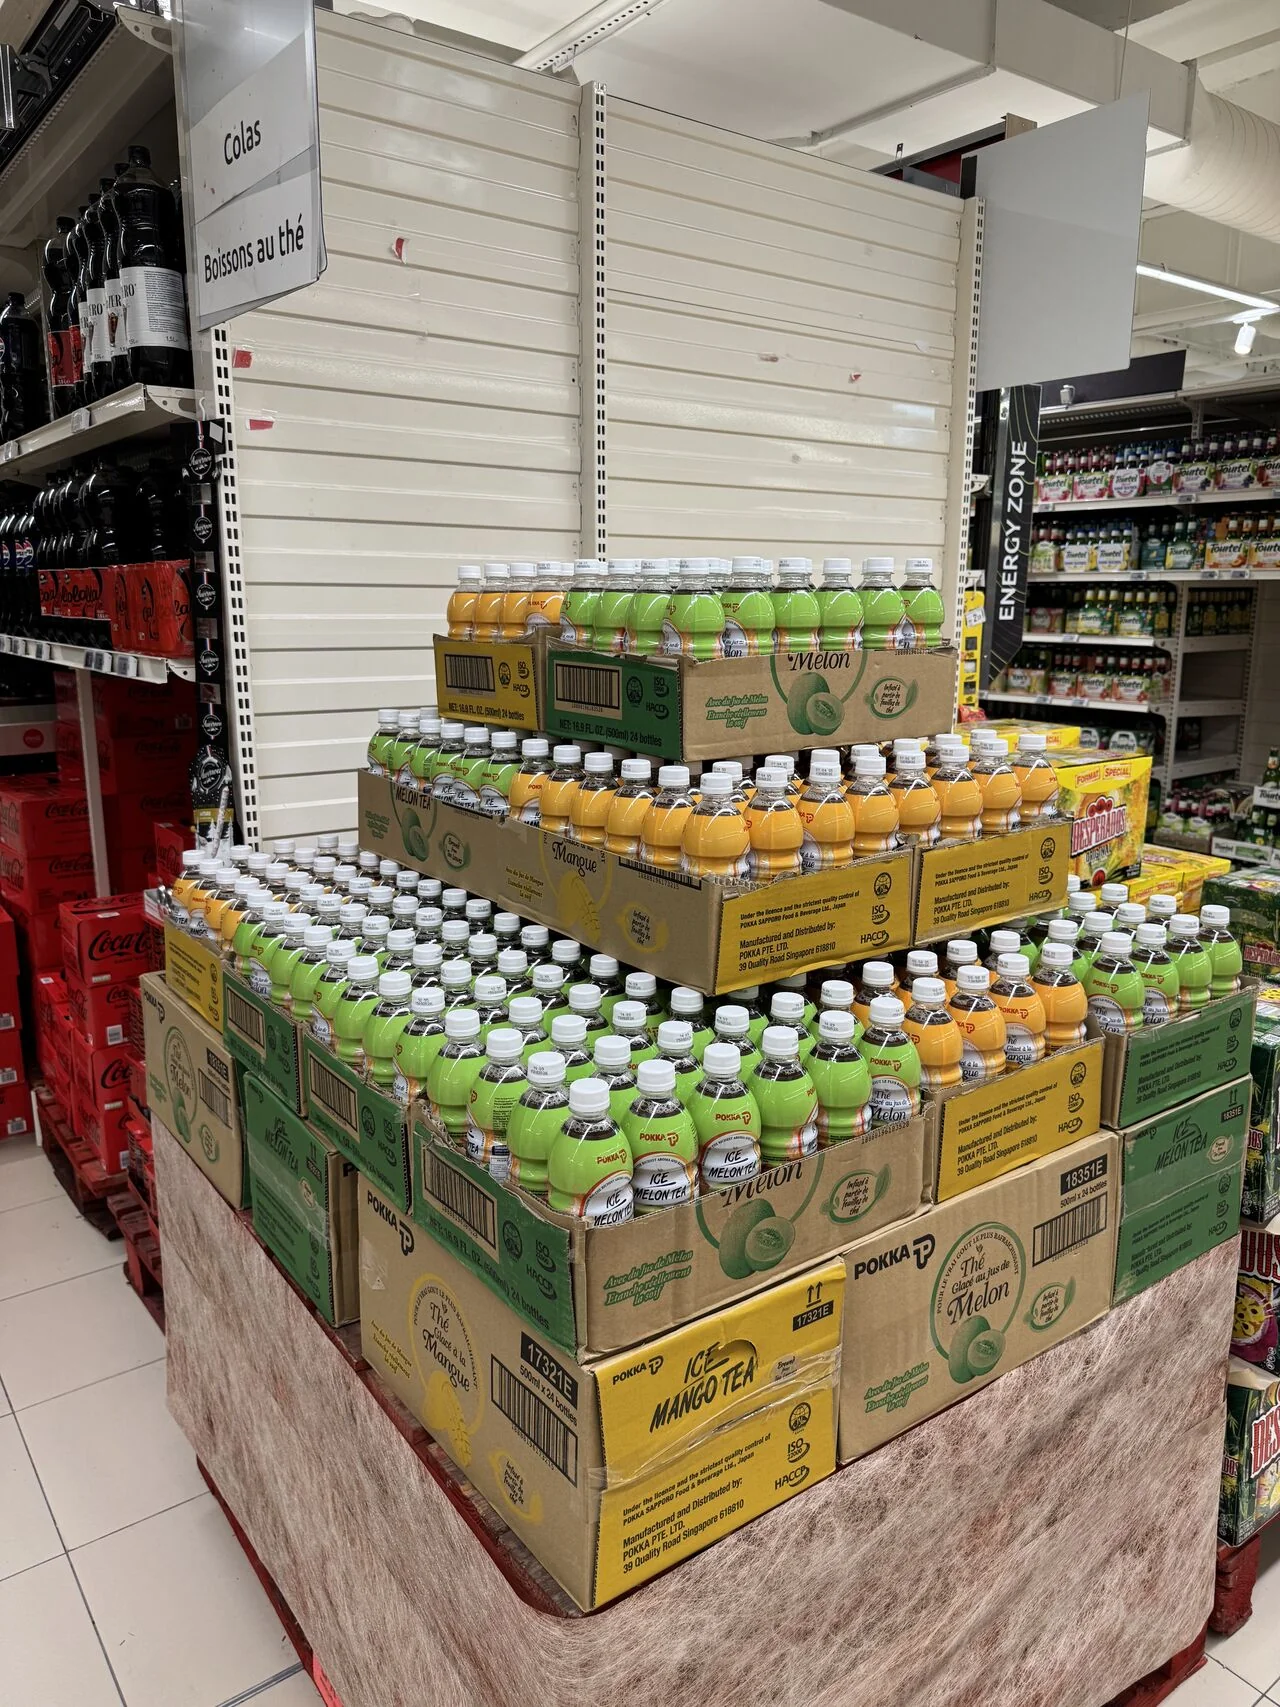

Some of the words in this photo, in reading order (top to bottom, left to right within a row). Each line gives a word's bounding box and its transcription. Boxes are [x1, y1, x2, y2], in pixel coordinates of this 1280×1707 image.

[223, 119, 261, 166] Colas
[204, 243, 253, 283] Boissons
[257, 234, 274, 263] au
[279, 214, 304, 257] thé
[1008, 441, 1027, 513] ZONE
[1220, 462, 1252, 473] Tourtel
[1211, 543, 1242, 553] Tourtel
[999, 514, 1022, 620] ENERGY
[787, 652, 850, 671] Melon
[1118, 680, 1144, 689] Tourtel
[449, 703, 458, 712] NET:
[459, 704, 469, 713] 16.9
[502, 709, 508, 718] 24
[508, 710, 524, 721] bottles
[559, 719, 570, 729] NET:
[572, 720, 585, 732] 16.9
[585, 722, 594, 733] FL.
[606, 726, 629, 741] (500ml)
[630, 729, 638, 742] 24
[639, 730, 662, 746] bottles
[1077, 771, 1099, 784] FORMAT
[1105, 767, 1129, 777] SPECIAL
[395, 787, 418, 806] MELON
[419, 794, 431, 811] TEA
[1073, 809, 1126, 853] DESPERADOS
[552, 841, 597, 877] Mangue
[1086, 844, 1111, 862] ORIGINAL
[1038, 866, 1050, 876] ISO
[934, 905, 950, 914] POKKA
[951, 901, 961, 910] PTE.
[963, 899, 972, 907] LTD.
[1029, 890, 1051, 901] HACCP
[872, 904, 885, 915] ISO
[933, 917, 940, 925] 39
[940, 913, 957, 923] Quality
[958, 910, 970, 919] Road
[970, 904, 993, 916] Singapore
[740, 932, 782, 949] Manufactured
[783, 929, 794, 940] and
[795, 923, 826, 937] Distributed
[827, 921, 835, 932] by:
[860, 930, 887, 944] HACCP
[739, 949, 761, 960] POKKA
[762, 945, 776, 956] PTE.
[776, 942, 789, 952] LTD.
[739, 961, 747, 971] 39
[748, 956, 768, 970] Quality
[769, 952, 785, 964] Road
[786, 946, 814, 962] Singapore
[816, 942, 836, 954] 618810
[870, 1058, 891, 1066] POKKA
[875, 1091, 891, 1099] Thé
[1068, 1092, 1080, 1103] ISO
[715, 1113, 741, 1121] POKKA
[1223, 1107, 1242, 1120] 18351E
[958, 1134, 992, 1153] Manufactured
[993, 1129, 1002, 1140] and
[1003, 1120, 1028, 1134] Distributed
[1028, 1115, 1037, 1126] by:
[1173, 1116, 1192, 1143] ICE
[596, 1152, 619, 1165] POKKA
[724, 1150, 742, 1163] ICE
[957, 1167, 964, 1176] 39
[965, 1159, 982, 1173] Quality
[983, 1155, 995, 1165] Road
[996, 1141, 1020, 1160] Singapore
[1155, 1143, 1188, 1171] MELON
[1189, 1131, 1208, 1157] TEA
[650, 1173, 669, 1185] ICE
[708, 1165, 744, 1178] MELON
[745, 1161, 756, 1173] TEA
[1065, 1159, 1103, 1189] 18351E
[633, 1188, 669, 1200] MELON
[671, 1186, 686, 1198] TEA
[720, 1161, 802, 1208] Melon
[1060, 1195, 1077, 1208] 500ml
[1082, 1189, 1089, 1198] 24
[1089, 1179, 1107, 1194] bottles
[367, 1189, 399, 1232] POKKA
[606, 1190, 621, 1209] ICE
[593, 1209, 621, 1226] MELON
[604, 1275, 628, 1289] Avec
[628, 1267, 640, 1280] du
[655, 1256, 665, 1270] de
[666, 1248, 693, 1265] Melon
[854, 1243, 911, 1281] POKKA
[941, 1279, 948, 1289] LE
[946, 1259, 957, 1277] VRAI
[957, 1240, 972, 1259] GOUT
[973, 1236, 980, 1244] LE
[961, 1252, 986, 1278] Thé
[952, 1276, 975, 1294] Glacé
[975, 1272, 985, 1283] au
[986, 1266, 999, 1280] jus
[1000, 1260, 1010, 1271] de
[796, 1305, 829, 1327] 17321E
[947, 1280, 1009, 1325] Melon
[430, 1301, 449, 1333] Thé
[422, 1329, 470, 1392] Mangue
[527, 1342, 572, 1400] 17321E
[612, 1362, 646, 1385] POKKA
[684, 1341, 720, 1383] ICE
[520, 1365, 540, 1389] 500ml
[541, 1385, 546, 1394] x
[546, 1389, 555, 1403] 24
[556, 1398, 577, 1426] bottles
[650, 1374, 719, 1432] MANGO
[722, 1353, 755, 1396] TEA
[787, 1438, 804, 1453] ISO
[623, 1502, 641, 1516] Under
[643, 1495, 653, 1505] the
[654, 1485, 676, 1501] licence
[677, 1481, 688, 1490] and
[689, 1475, 699, 1484] the
[700, 1459, 724, 1477] strictest
[724, 1448, 744, 1464] quality
[744, 1437, 764, 1452] control
[764, 1433, 771, 1443] of
[774, 1465, 807, 1490] HACCP
[623, 1510, 645, 1526] POKKA
[645, 1494, 674, 1515] SAPPORO
[675, 1488, 690, 1500] Food
[696, 1469, 724, 1486] Beverage
[724, 1461, 737, 1473] Ltd.,
[737, 1451, 754, 1466] Japan
[623, 1510, 676, 1548] Manufactured
[677, 1505, 691, 1521] and
[692, 1482, 731, 1510] Distributed
[731, 1477, 743, 1491] by:
[623, 1562, 633, 1574] 39
[634, 1547, 661, 1568] Quality
[662, 1533, 681, 1551] Road
[682, 1514, 718, 1541] Singapore
[719, 1499, 745, 1521] 618810
[623, 1543, 650, 1562] POKKA
[651, 1530, 668, 1547] PTE.
[669, 1520, 685, 1537] LTD.
